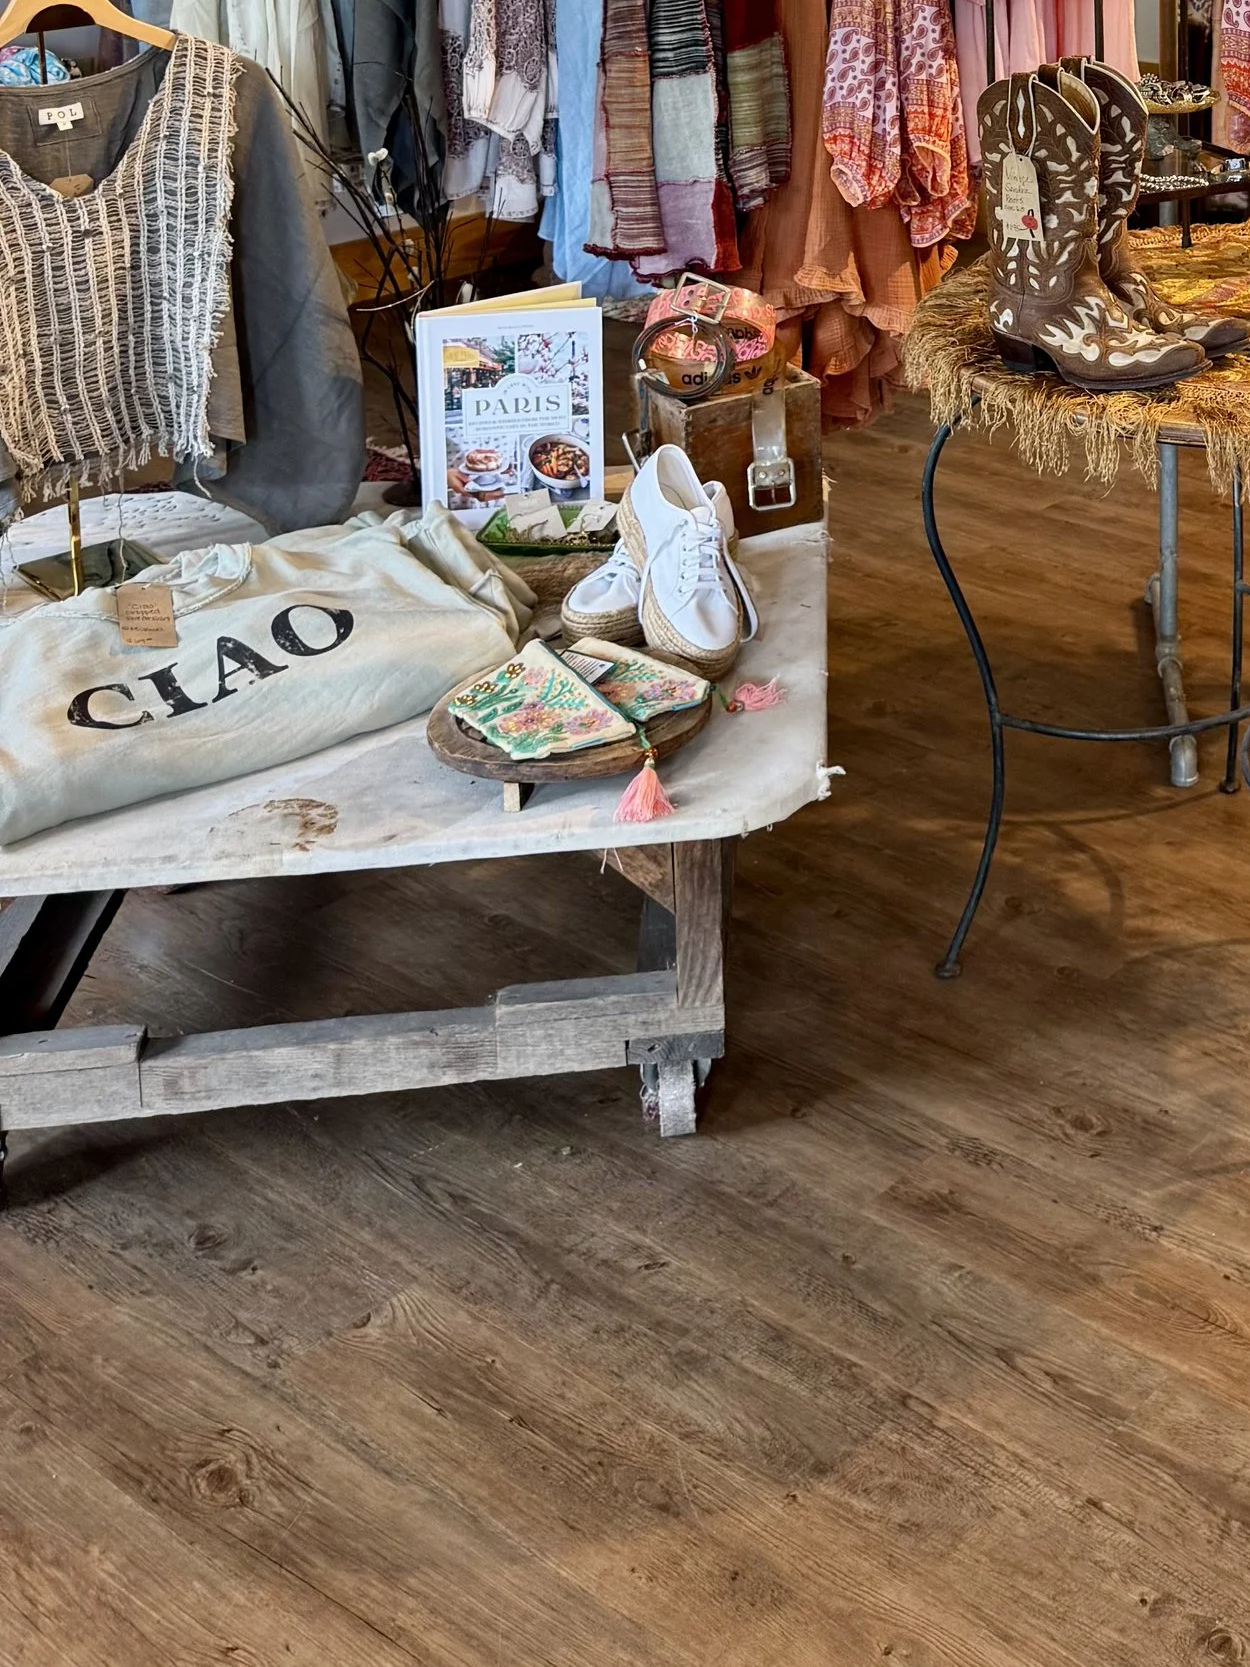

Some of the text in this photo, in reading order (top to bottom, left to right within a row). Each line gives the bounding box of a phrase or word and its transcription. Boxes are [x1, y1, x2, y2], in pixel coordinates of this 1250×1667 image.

[681, 370, 741, 386] adis
[475, 394, 560, 416] PARIS
[67, 604, 354, 729] CIAO
